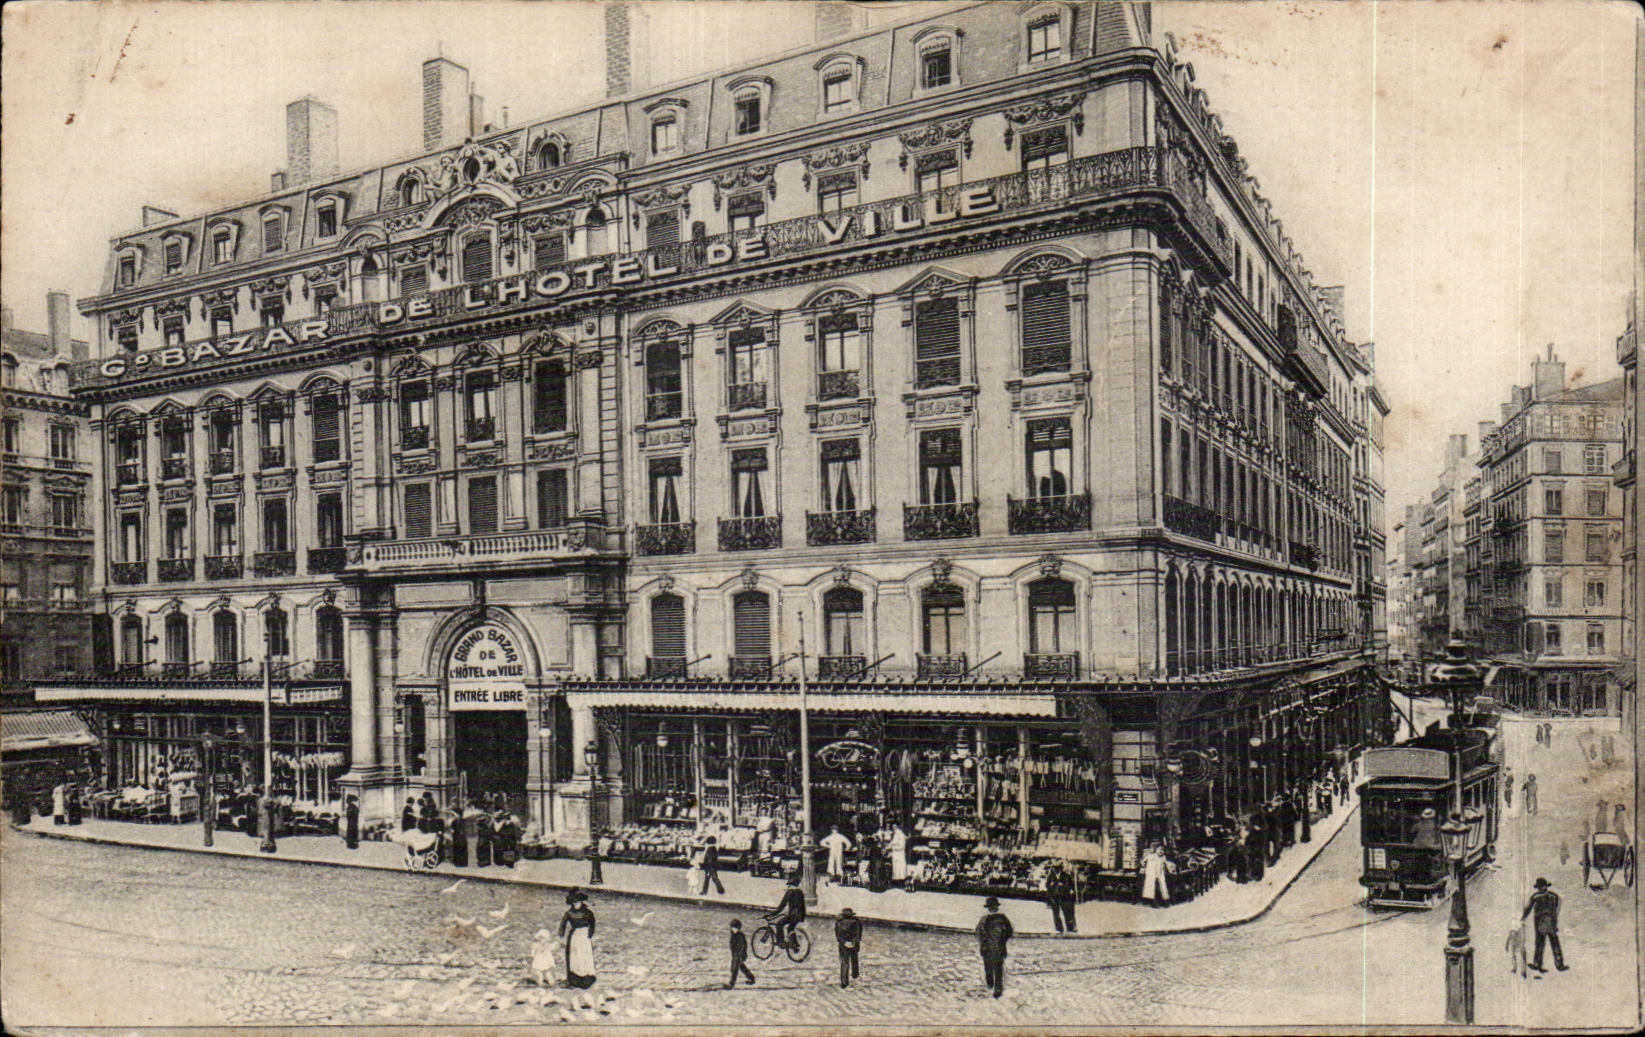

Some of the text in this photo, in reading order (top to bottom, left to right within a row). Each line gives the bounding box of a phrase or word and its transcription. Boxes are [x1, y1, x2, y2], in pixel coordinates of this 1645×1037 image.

[162, 321, 328, 367] BAZAR
[379, 300, 432, 323] DE
[464, 255, 677, 309] L'HOTEL
[708, 237, 765, 265] DE
[819, 187, 998, 243] VILLE
[454, 630, 518, 663] GRAND BAZAR
[480, 651, 496, 660] DE
[450, 664, 485, 678] L'HÔTEL
[497, 665, 523, 676] VILLE
[454, 688, 523, 703] ENTRÉE LIBRE
